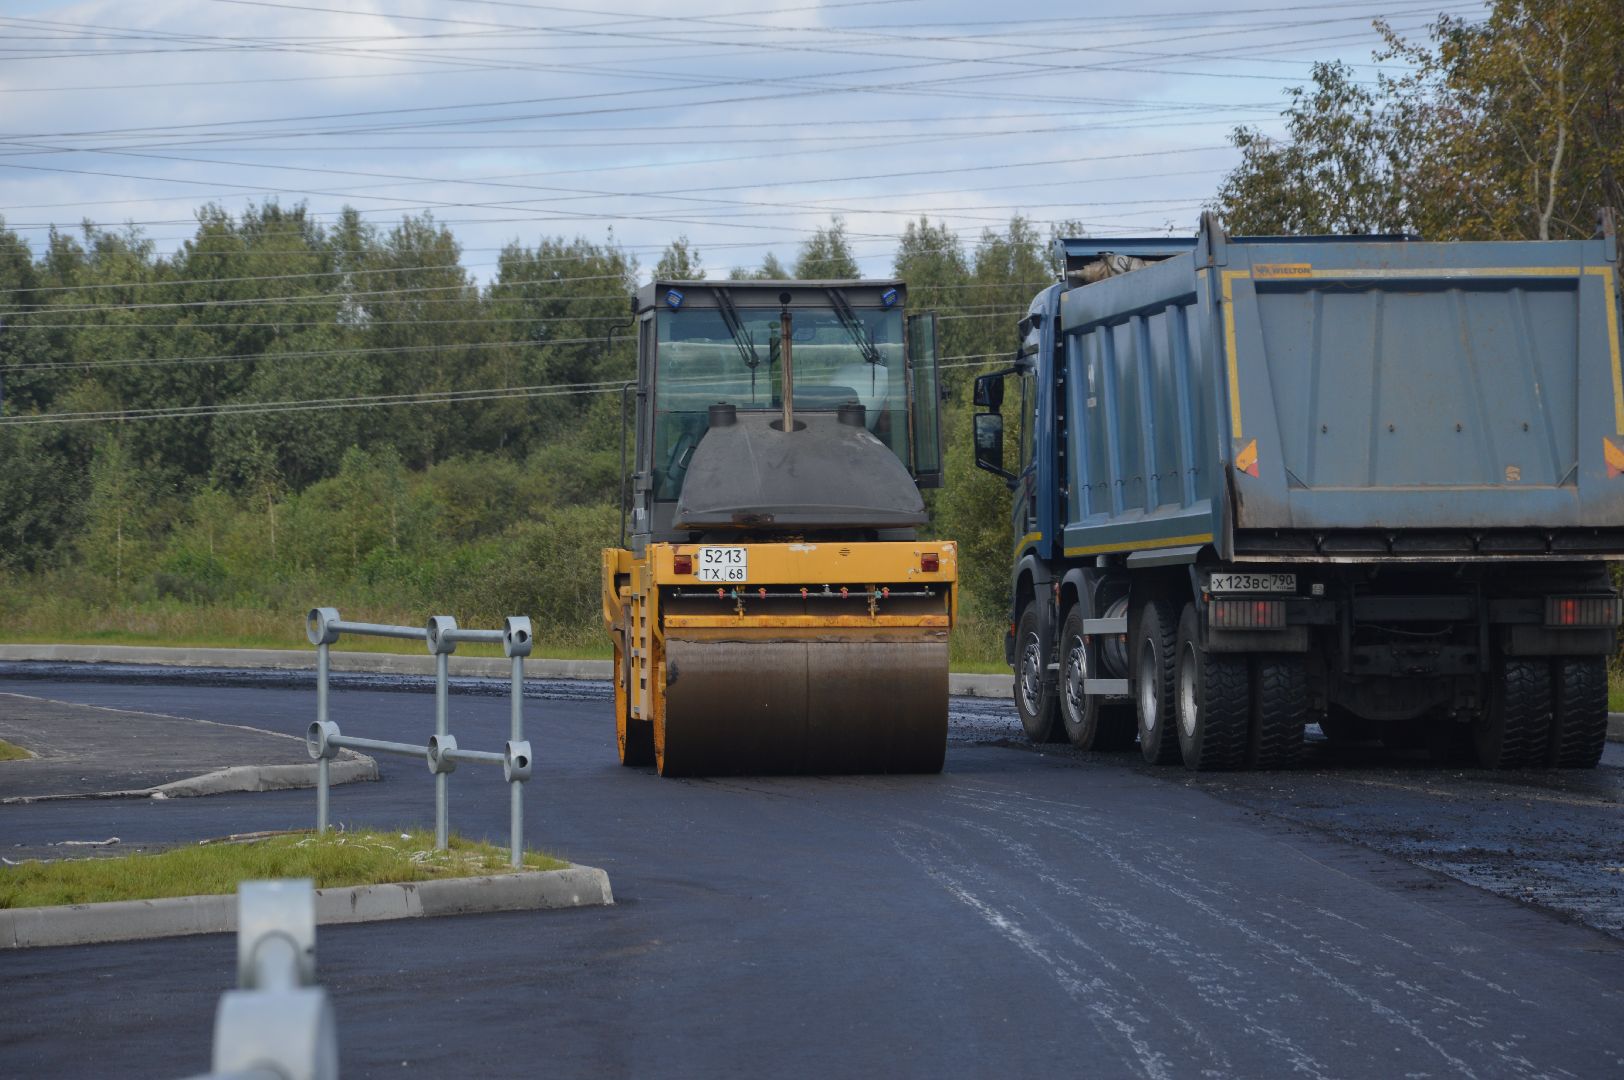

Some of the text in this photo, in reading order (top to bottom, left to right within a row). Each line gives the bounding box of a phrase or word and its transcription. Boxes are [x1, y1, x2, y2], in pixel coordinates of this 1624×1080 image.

[1272, 267, 1311, 275] WIELTON
[705, 549, 742, 563] 5213
[728, 568, 743, 580] 68
[1271, 574, 1294, 586] 790
